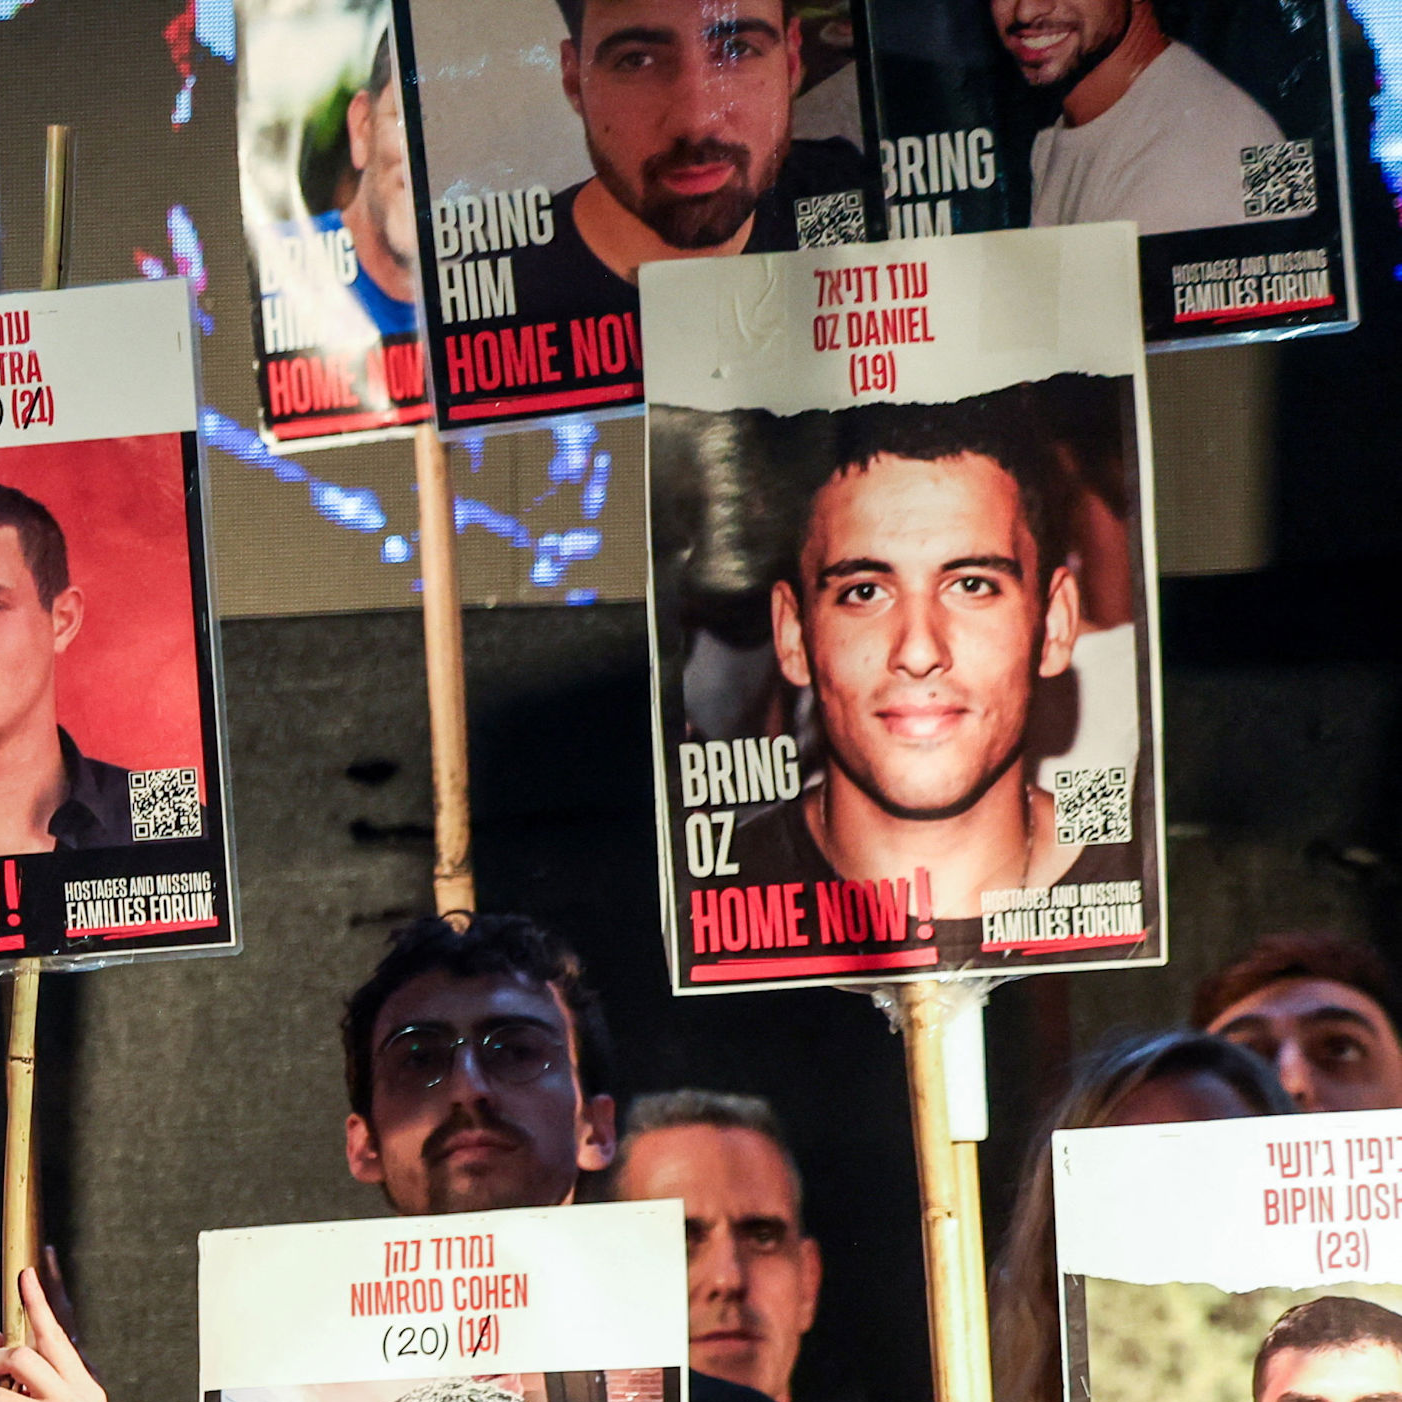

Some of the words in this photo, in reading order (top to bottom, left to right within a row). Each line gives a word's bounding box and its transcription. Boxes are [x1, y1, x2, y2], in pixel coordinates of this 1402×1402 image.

[432, 186, 555, 258] BRING
[440, 256, 518, 324] HIM
[813, 266, 879, 308] דניאל
[886, 262, 929, 301] עוז
[1172, 260, 1238, 286] HOSTAGES
[1174, 280, 1258, 314] FAMILIES
[1261, 271, 1329, 308] FORUM
[813, 313, 842, 352] OZ
[846, 306, 935, 348] DANIEL
[445, 322, 562, 395] HOME
[849, 351, 897, 397] (19)
[679, 735, 800, 808] BRING
[685, 811, 740, 878] OZ
[64, 881, 128, 904] HOSTAGES
[129, 879, 155, 896] AND
[155, 872, 212, 894] MISSING
[981, 888, 1050, 913] HOSTAGES
[1051, 885, 1078, 908] AND
[1079, 881, 1142, 905] MISSING
[65, 897, 147, 931] FAMILIES
[150, 891, 215, 924] FORUM
[691, 882, 809, 953] HOME
[815, 866, 934, 945] NOW!
[983, 913, 1070, 945] FAMILIES
[1072, 905, 1143, 939] FORUM
[1263, 1186, 1334, 1226] BIPIN
[384, 1240, 422, 1278] כהן
[430, 1234, 495, 1271] נמרוד
[1316, 1228, 1370, 1274] (23)
[350, 1278, 444, 1317] NIMROD
[453, 1273, 529, 1311] COHEN
[382, 1323, 450, 1363] (20)
